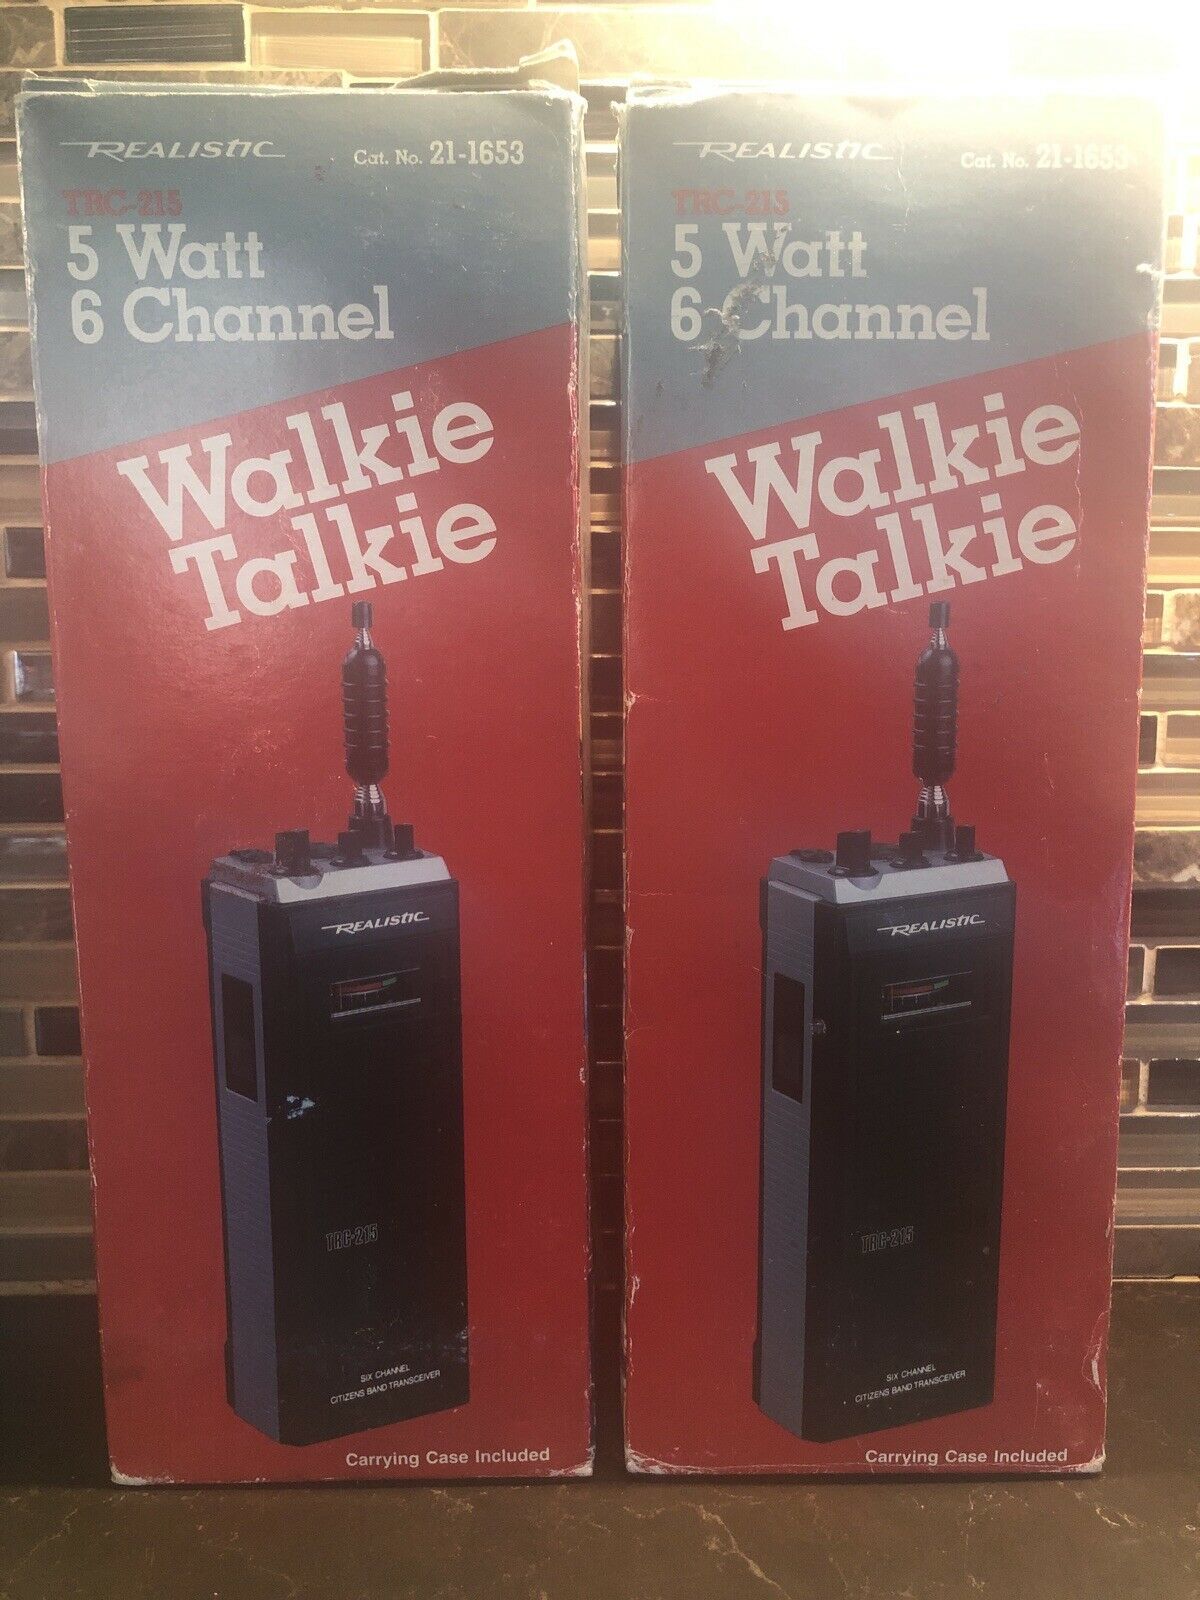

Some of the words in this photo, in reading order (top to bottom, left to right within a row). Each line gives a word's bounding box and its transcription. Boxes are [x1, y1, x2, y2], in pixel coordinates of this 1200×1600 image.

[354, 149, 390, 166] Cat.
[395, 149, 424, 166] No.
[430, 140, 525, 166] 21-1653
[960, 151, 996, 169] Cat.
[1001, 151, 1030, 169] No.
[1036, 143, 1130, 170] 21-1653
[62, 189, 183, 217] TRC-215
[671, 189, 790, 216] TRC-215
[67, 225, 100, 280] 5
[116, 223, 266, 280] Watt
[670, 224, 702, 279] 5
[721, 222, 868, 279] Watt
[70, 288, 104, 345] 6
[122, 285, 395, 343] Channel
[670, 286, 702, 343] 6
[721, 285, 991, 342] Channel
[116, 390, 495, 542] Walkie
[704, 392, 1081, 541] Walkie
[168, 492, 498, 632] Talkie
[750, 493, 1078, 632] Talkie
[325, 1223, 379, 1252] TRC-215
[860, 1225, 914, 1254] TRC-215
[330, 1388, 366, 1405] CITIZENS
[366, 1383, 388, 1396] BAND
[389, 1369, 441, 1390] TRANSCEIVER
[360, 1372, 374, 1383] SIX
[375, 1363, 411, 1380] CHANNEL
[854, 1388, 890, 1403] CITIZENS
[891, 1382, 913, 1395] BAND
[914, 1369, 966, 1389] TRANSCEIVER
[886, 1372, 899, 1382] SIX
[900, 1363, 937, 1379] CHANNEL
[345, 1452, 420, 1469] Carrying
[425, 1450, 469, 1465] Case
[475, 1447, 551, 1463] Included
[865, 1450, 939, 1467] Carrying
[944, 1450, 988, 1463] Case
[994, 1448, 1068, 1463] Included
